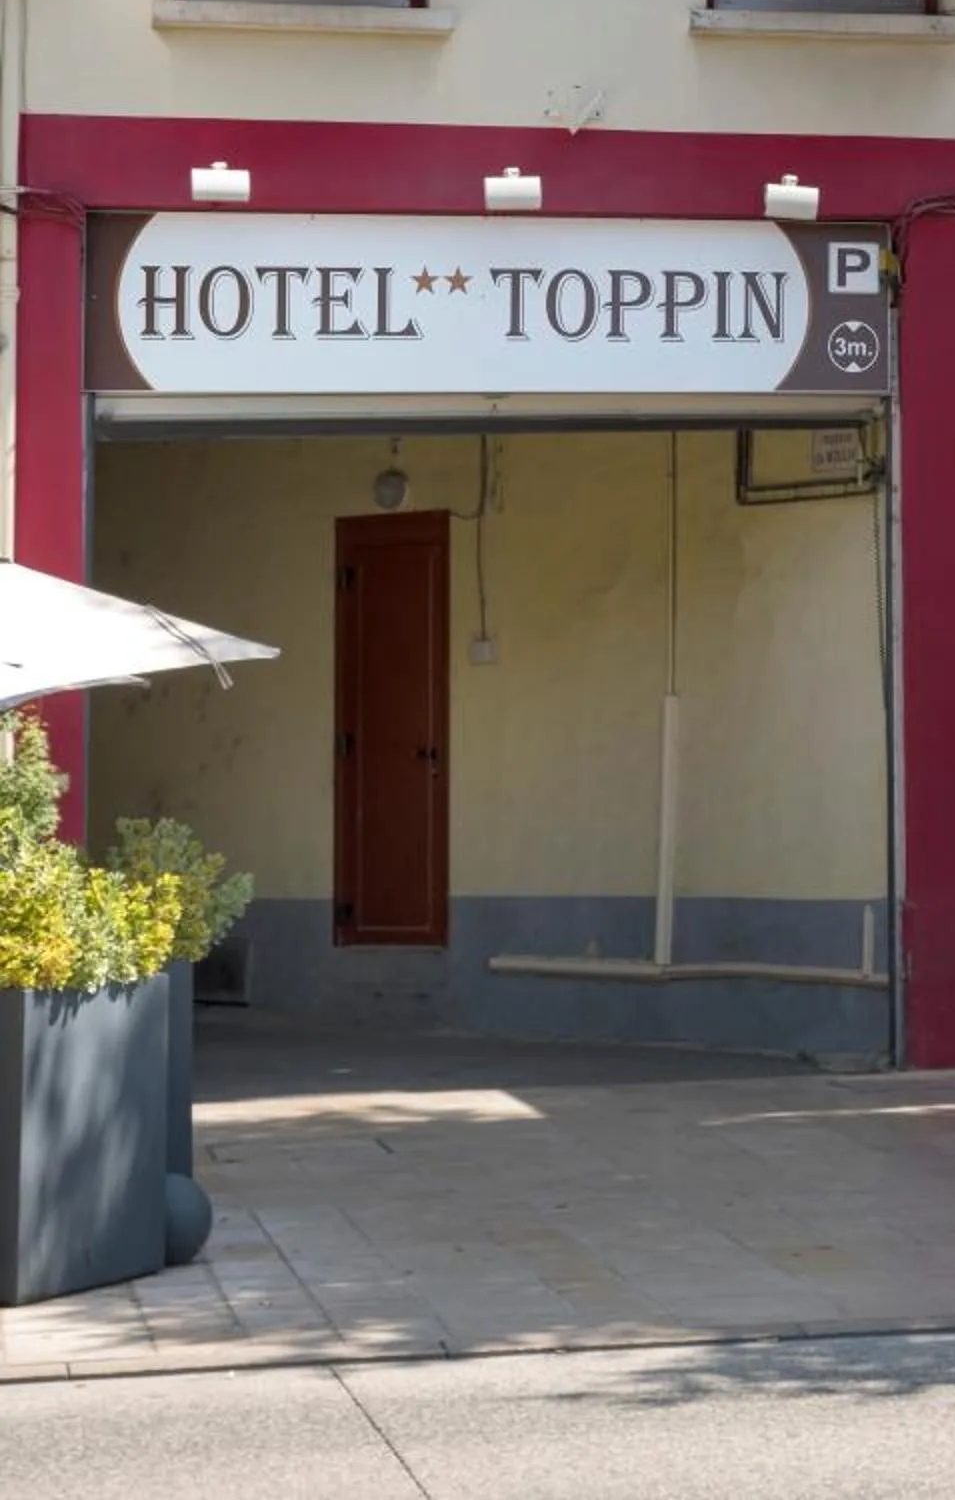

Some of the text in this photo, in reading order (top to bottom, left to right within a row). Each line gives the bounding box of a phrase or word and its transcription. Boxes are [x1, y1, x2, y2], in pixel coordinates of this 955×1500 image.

[836, 247, 871, 288] P
[137, 264, 791, 343] HOTEL TOPPIN
